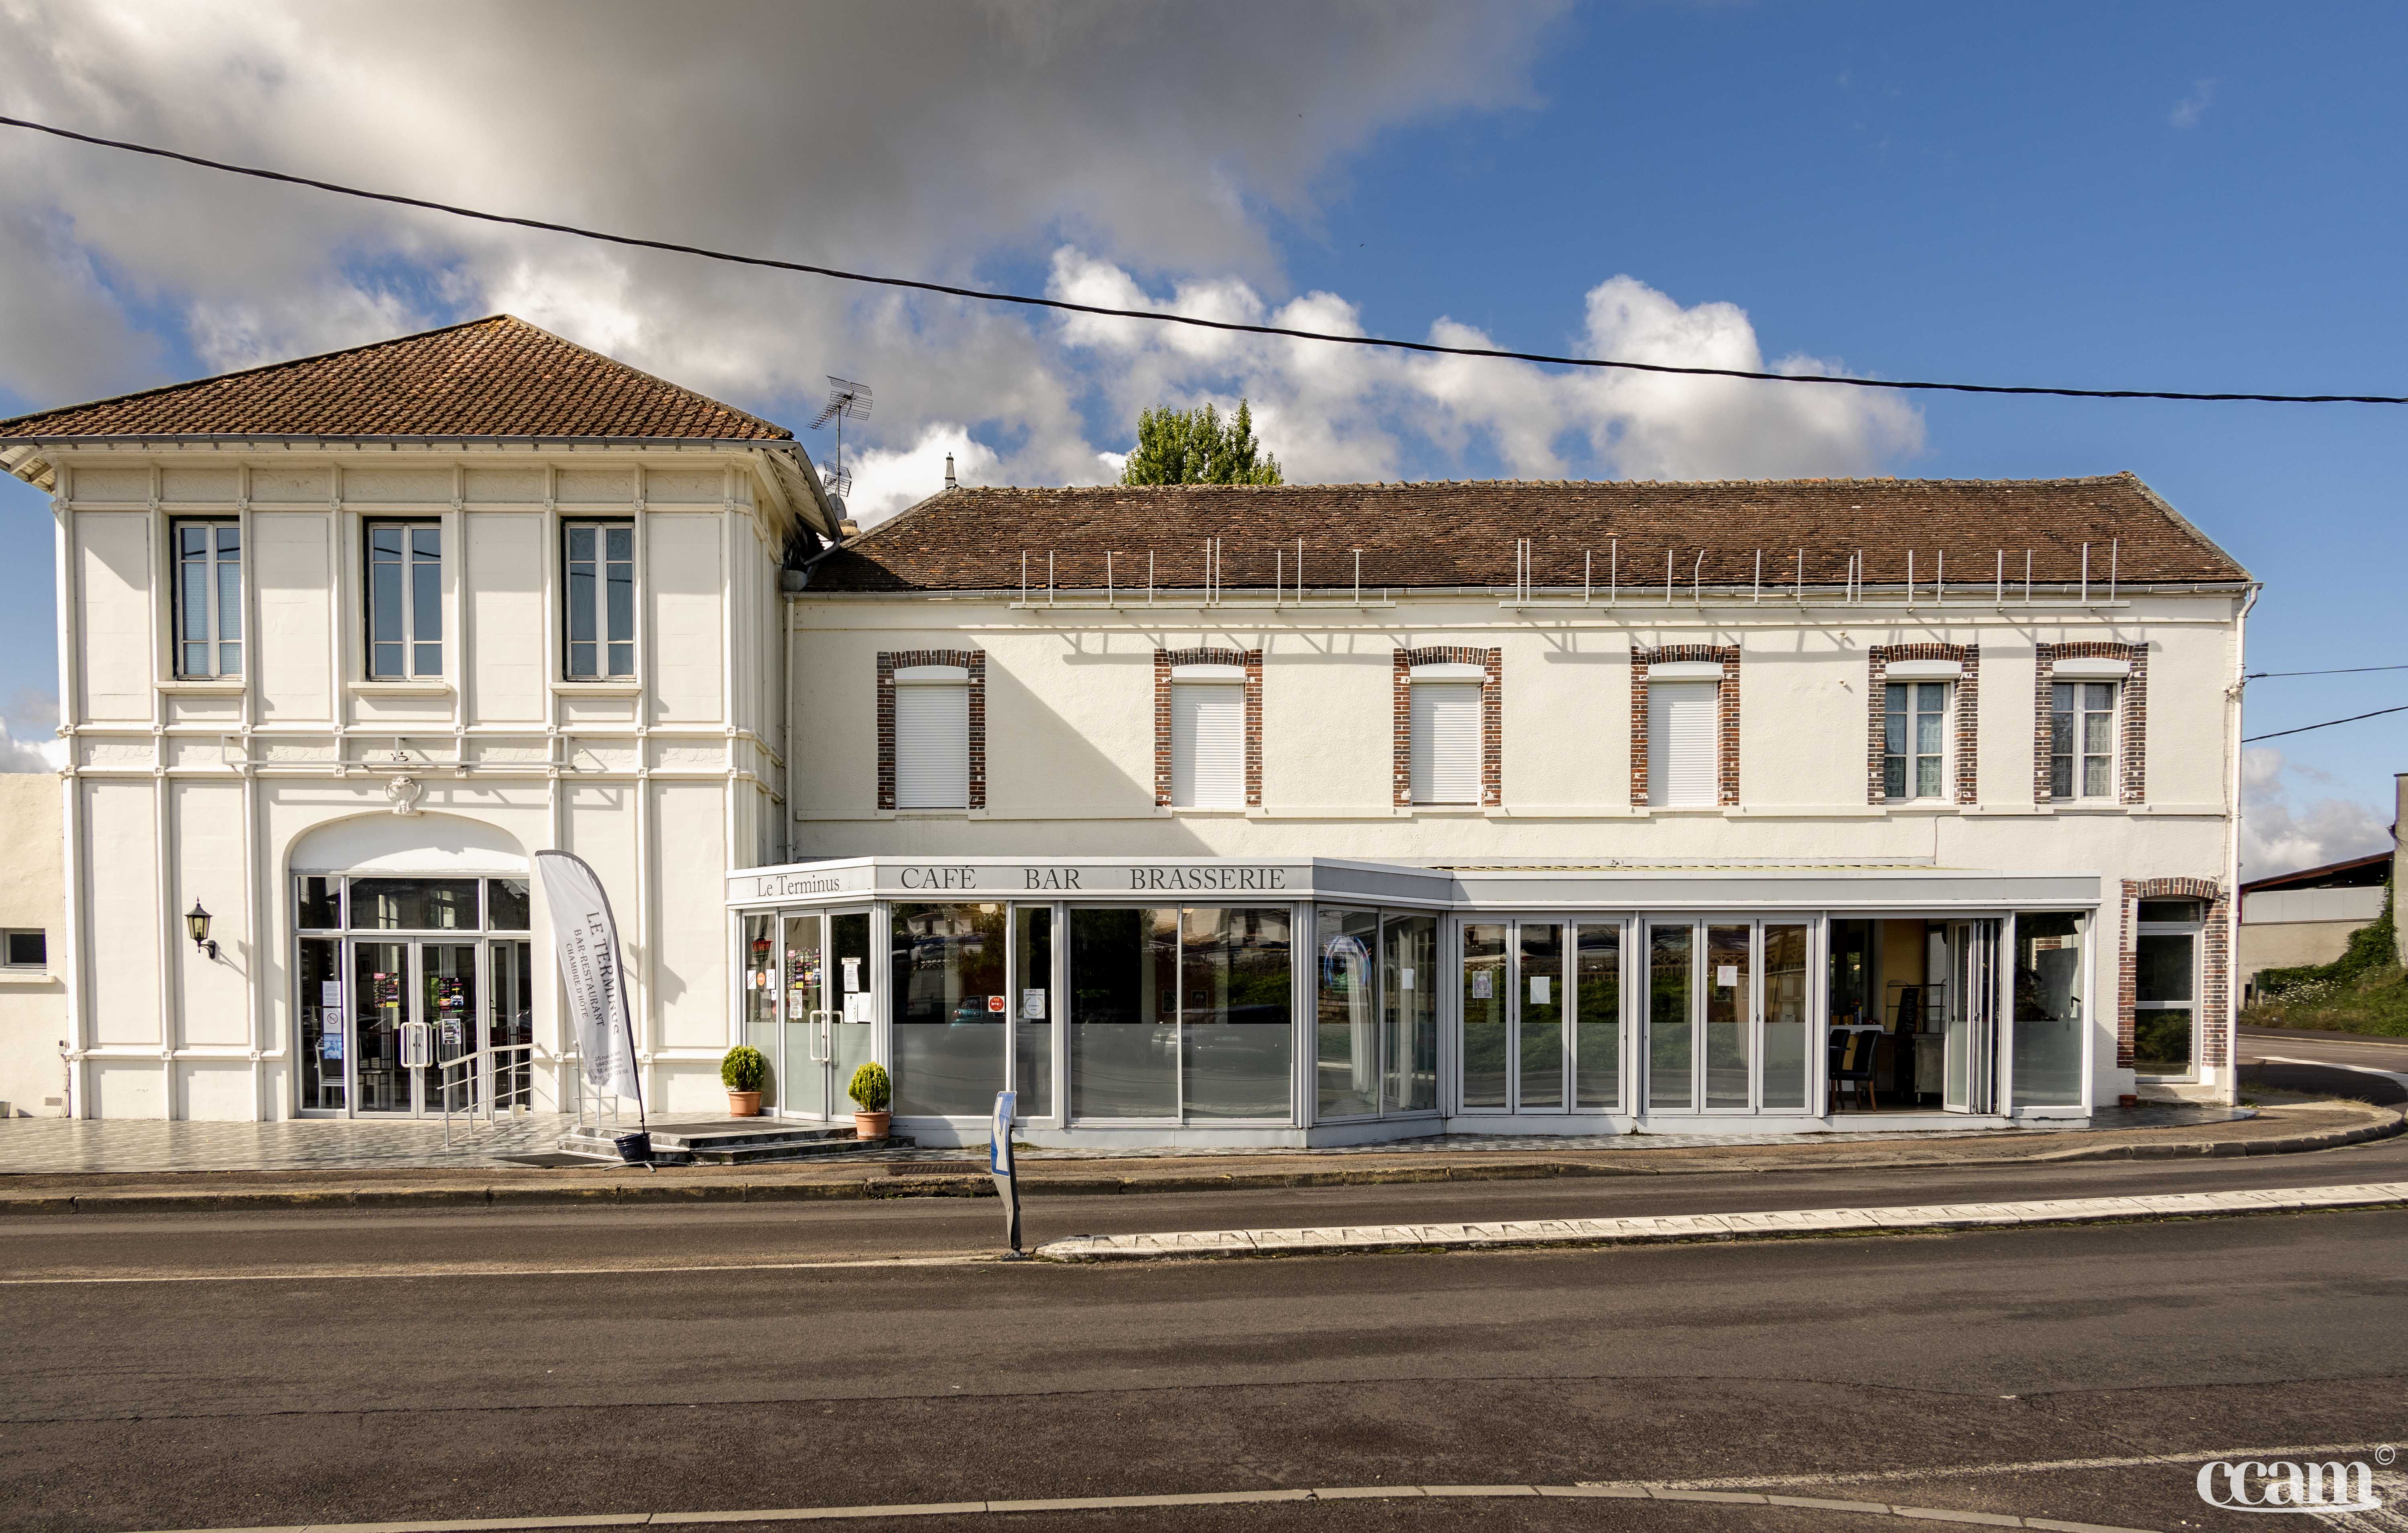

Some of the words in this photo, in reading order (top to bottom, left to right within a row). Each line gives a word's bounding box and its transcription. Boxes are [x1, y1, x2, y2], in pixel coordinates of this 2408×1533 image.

[757, 878, 773, 897] Le
[776, 875, 840, 895] Terminus
[901, 865, 977, 889] CAFÉ
[1024, 868, 1082, 889] BAR
[1130, 868, 1286, 890] BRASSERIE
[586, 911, 604, 936] LE
[565, 943, 581, 986] CHAMBRE
[574, 929, 605, 1027] BAR-RESTAURANT
[594, 938, 619, 1035] TERMINUS
